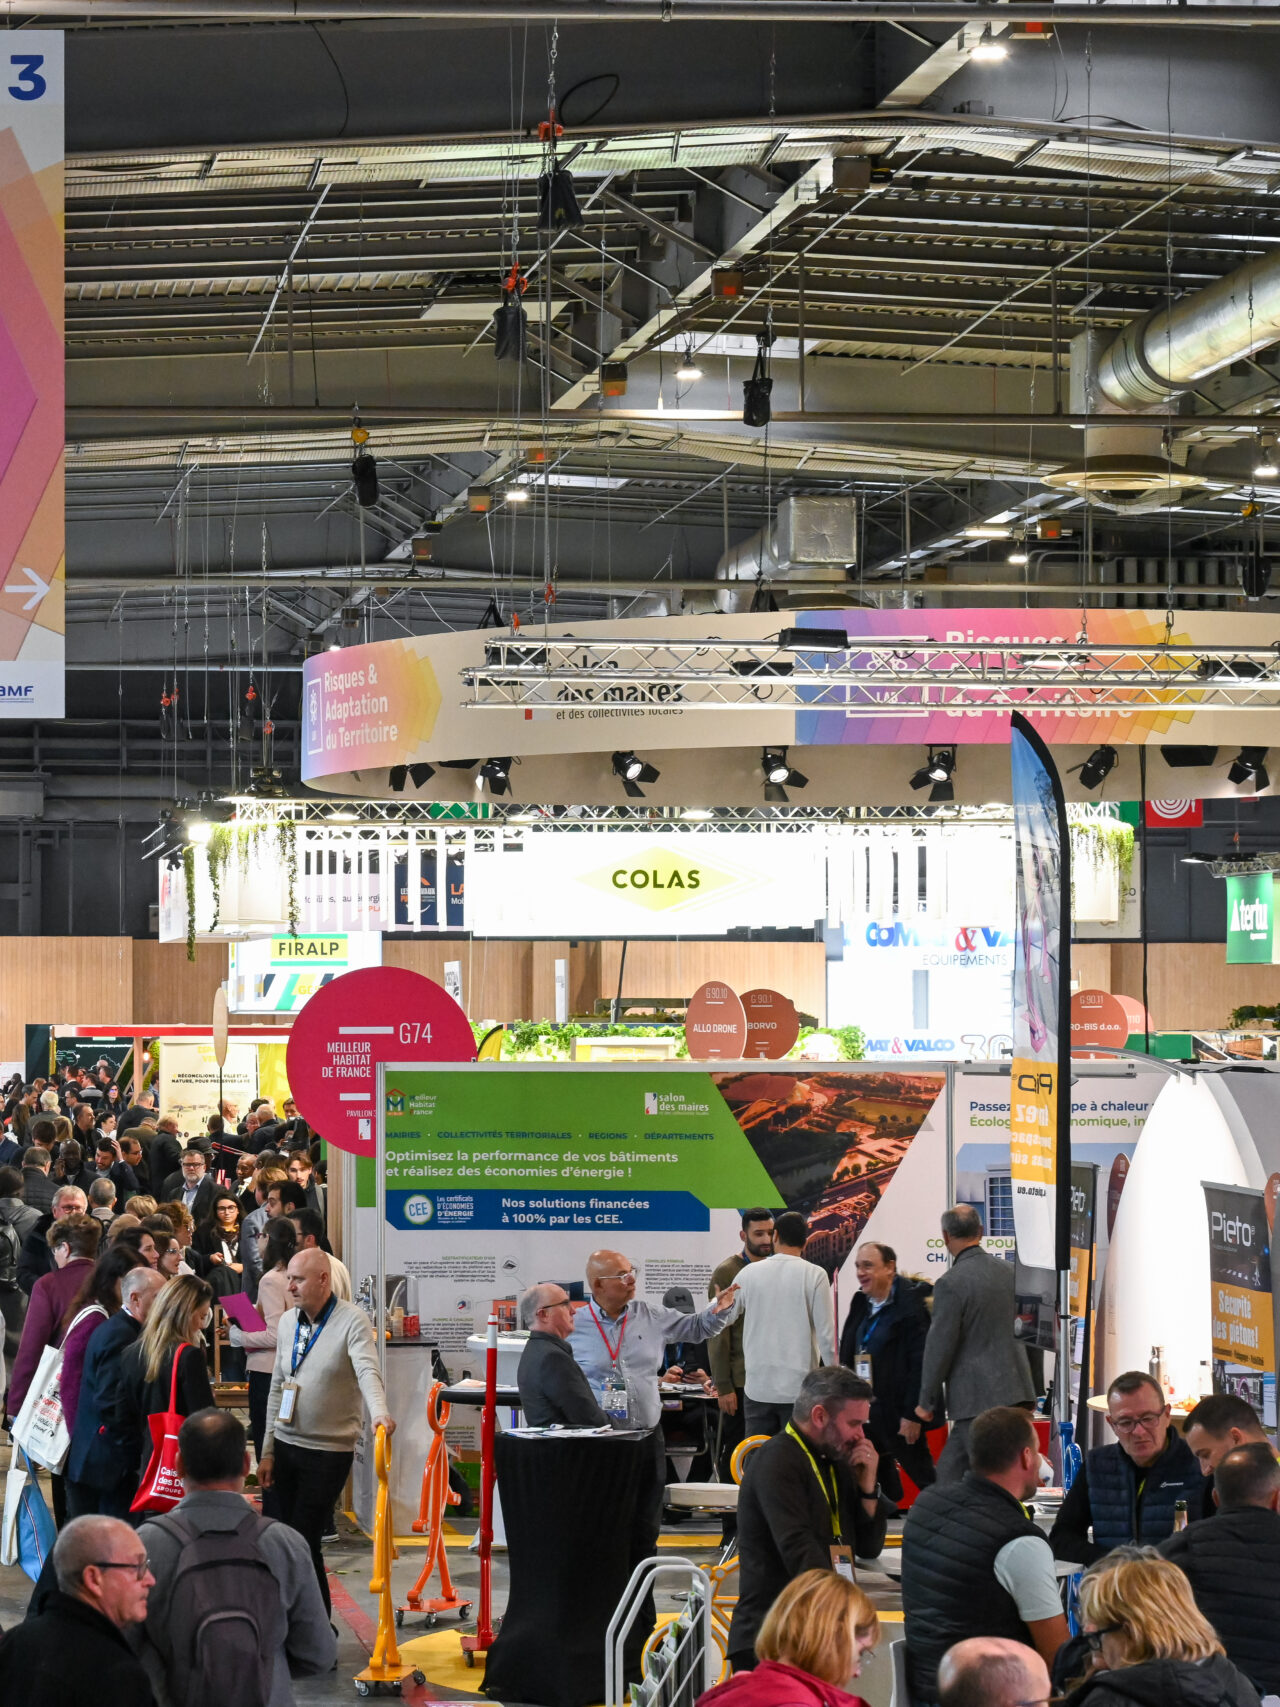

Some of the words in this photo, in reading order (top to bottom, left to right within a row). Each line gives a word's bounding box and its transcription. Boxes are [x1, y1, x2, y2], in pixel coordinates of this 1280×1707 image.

[8, 54, 47, 101] 3
[324, 669, 365, 694] Risques
[368, 664, 378, 685] &
[325, 693, 388, 723] Adaptation
[556, 710, 565, 720] et
[569, 709, 584, 720] des
[326, 730, 337, 750] du
[339, 721, 398, 747] Territoire
[612, 869, 700, 889] COLAS
[279, 942, 339, 956] FIRALP
[923, 954, 1007, 966] EQUIPEMENTS
[400, 1022, 432, 1044] G74
[693, 1024, 711, 1033] ALLO
[713, 1024, 737, 1033] DRONE
[327, 1042, 371, 1053] MEILLEUR
[333, 1054, 371, 1065] HABITAT
[322, 1066, 335, 1078] DE
[337, 1066, 371, 1078] FRANCE
[659, 1093, 685, 1102] salon
[659, 1102, 676, 1111] des
[678, 1103, 710, 1111] maires
[1091, 1101, 1098, 1111] à
[1101, 1101, 1148, 1112] chaleur
[346, 1109, 372, 1117] PAVILLON
[437, 1130, 502, 1139] COLLECTIVITÉS
[505, 1131, 572, 1139] TERRITORIALES
[644, 1131, 714, 1140] DÉPARTEMENTS
[386, 1150, 453, 1163] Optimisez
[457, 1151, 469, 1161] la
[472, 1151, 558, 1163] performance
[563, 1151, 580, 1162] de
[583, 1153, 606, 1162] vos
[610, 1151, 678, 1163] bâtiments
[386, 1167, 399, 1177] et
[403, 1166, 453, 1177] réalisez
[457, 1166, 481, 1177] des
[484, 1166, 557, 1177] économies
[561, 1166, 625, 1180] d'énergie
[408, 1202, 429, 1217] CEE
[502, 1198, 525, 1208] Nos
[529, 1198, 586, 1209] solutions
[589, 1198, 650, 1209] financées
[502, 1212, 510, 1223] à
[512, 1213, 546, 1223] 100%
[549, 1215, 570, 1226] par
[573, 1213, 591, 1223] les
[595, 1214, 623, 1224] CEE.
[1211, 1211, 1252, 1247] Pieto
[1218, 1289, 1252, 1319] Sécurité
[156, 1485, 182, 1495] GROUPE
